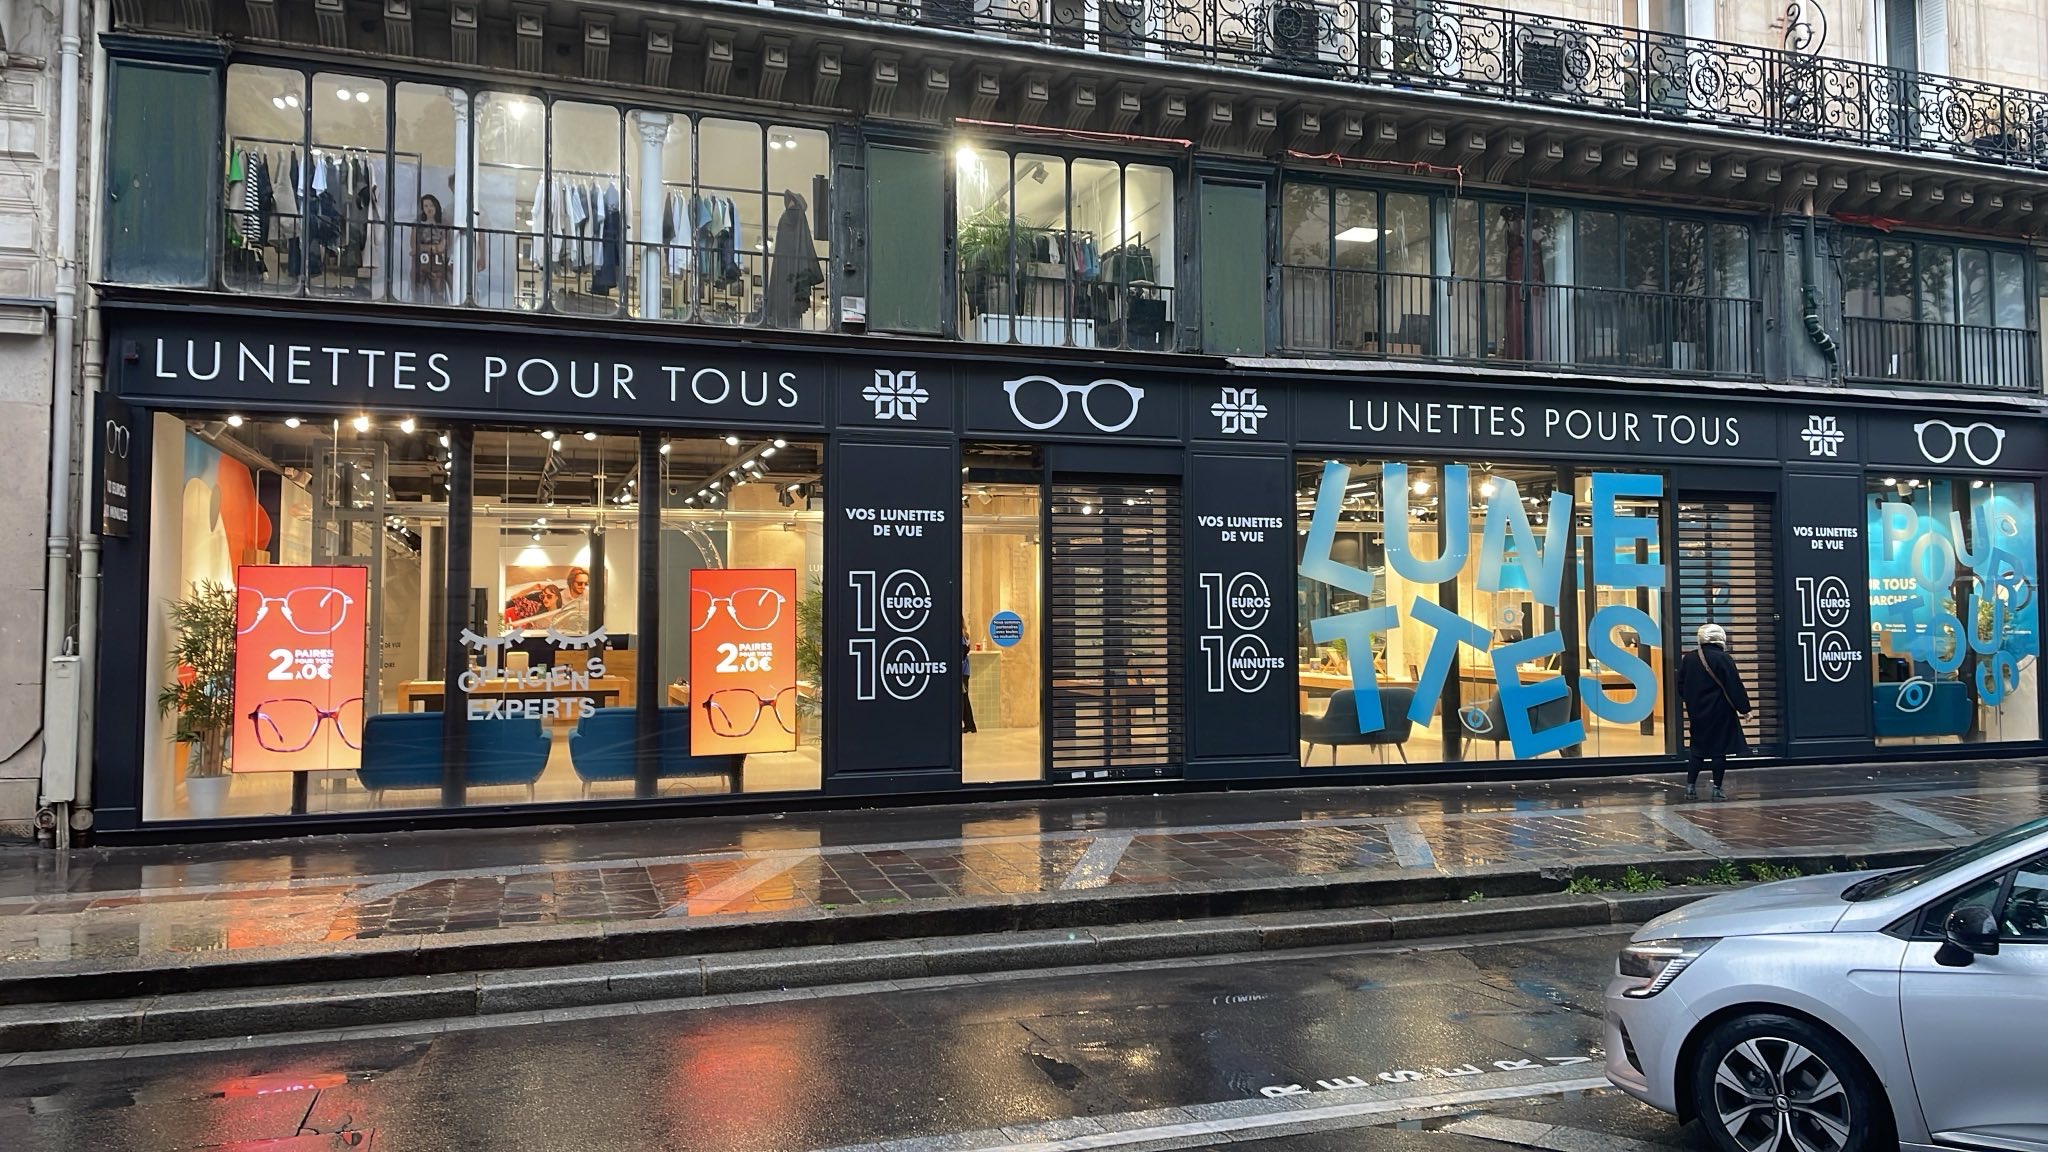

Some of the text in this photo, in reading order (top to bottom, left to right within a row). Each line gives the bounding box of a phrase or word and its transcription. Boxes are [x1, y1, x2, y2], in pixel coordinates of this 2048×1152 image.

[156, 338, 799, 408] LUNETTES POUR TOUS
[1349, 399, 1740, 447] LUNETTES POUR TOUS
[845, 508, 945, 522] VOS LUNETTES
[1198, 515, 1283, 528] VOS LUNETTES
[873, 525, 923, 537] DE VUE
[1221, 531, 1264, 542] DE VUE
[1298, 460, 1666, 608] LUNE
[1793, 527, 1858, 538] VOS LUNETTES
[1811, 540, 1844, 550] DE VUE
[1882, 578, 1917, 590] TOUS
[849, 569, 931, 633] 10
[886, 597, 932, 609] EUROS
[1200, 571, 1270, 631] 10
[1231, 597, 1271, 608] EUROS
[1796, 576, 1850, 628] 10
[1820, 599, 1850, 608] EUROS
[267, 648, 334, 681] 2 PAIRES
[716, 642, 773, 673] 2 PAIRES
[1200, 633, 1271, 693] 10
[1232, 657, 1285, 669] MINUTES
[1798, 630, 1851, 682] 10
[1822, 651, 1862, 661] MINUTES
[457, 657, 607, 692] OPTICIENS
[849, 636, 930, 700] 10
[885, 662, 947, 674] MINUTES
[467, 696, 597, 721] EXPERTS
